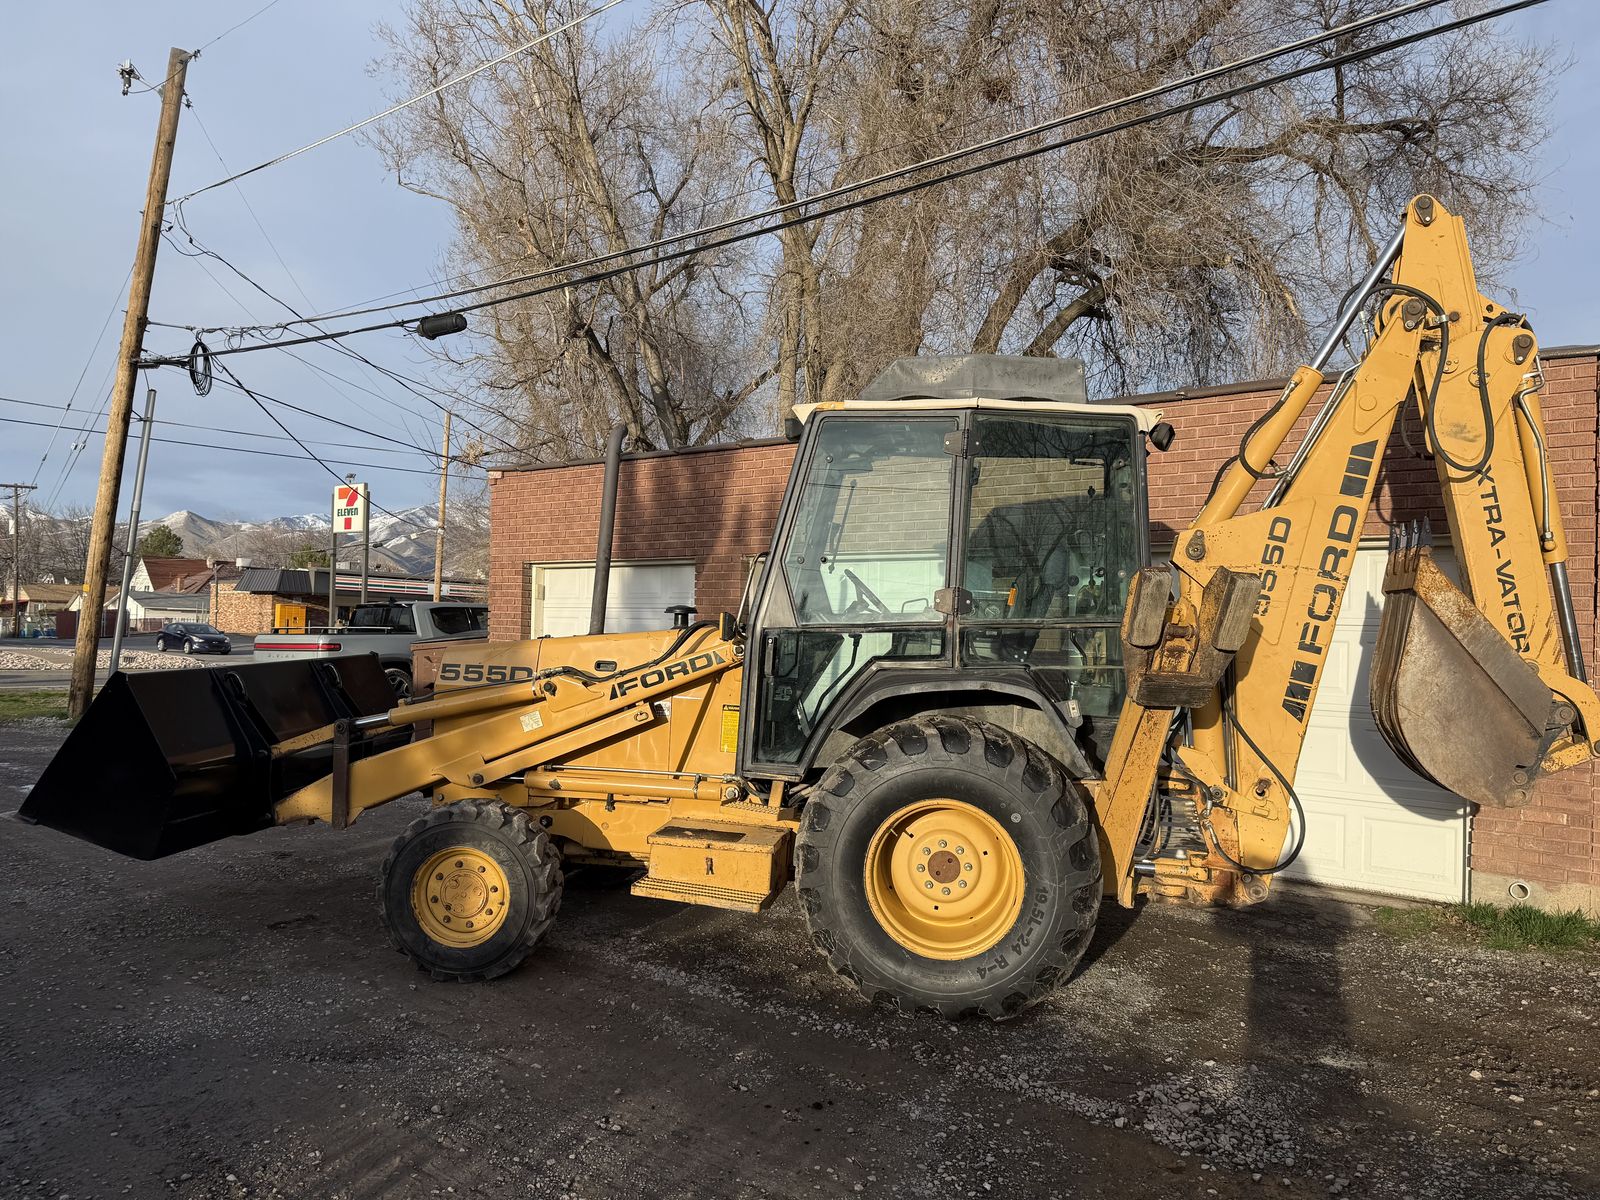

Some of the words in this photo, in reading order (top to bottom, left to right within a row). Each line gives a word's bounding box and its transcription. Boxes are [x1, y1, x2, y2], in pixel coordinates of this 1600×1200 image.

[338, 486, 359, 507] 7
[1297, 504, 1360, 655] FORD
[440, 663, 534, 682] 555D
[617, 652, 714, 697] FORD
[976, 954, 1010, 979] R-4
